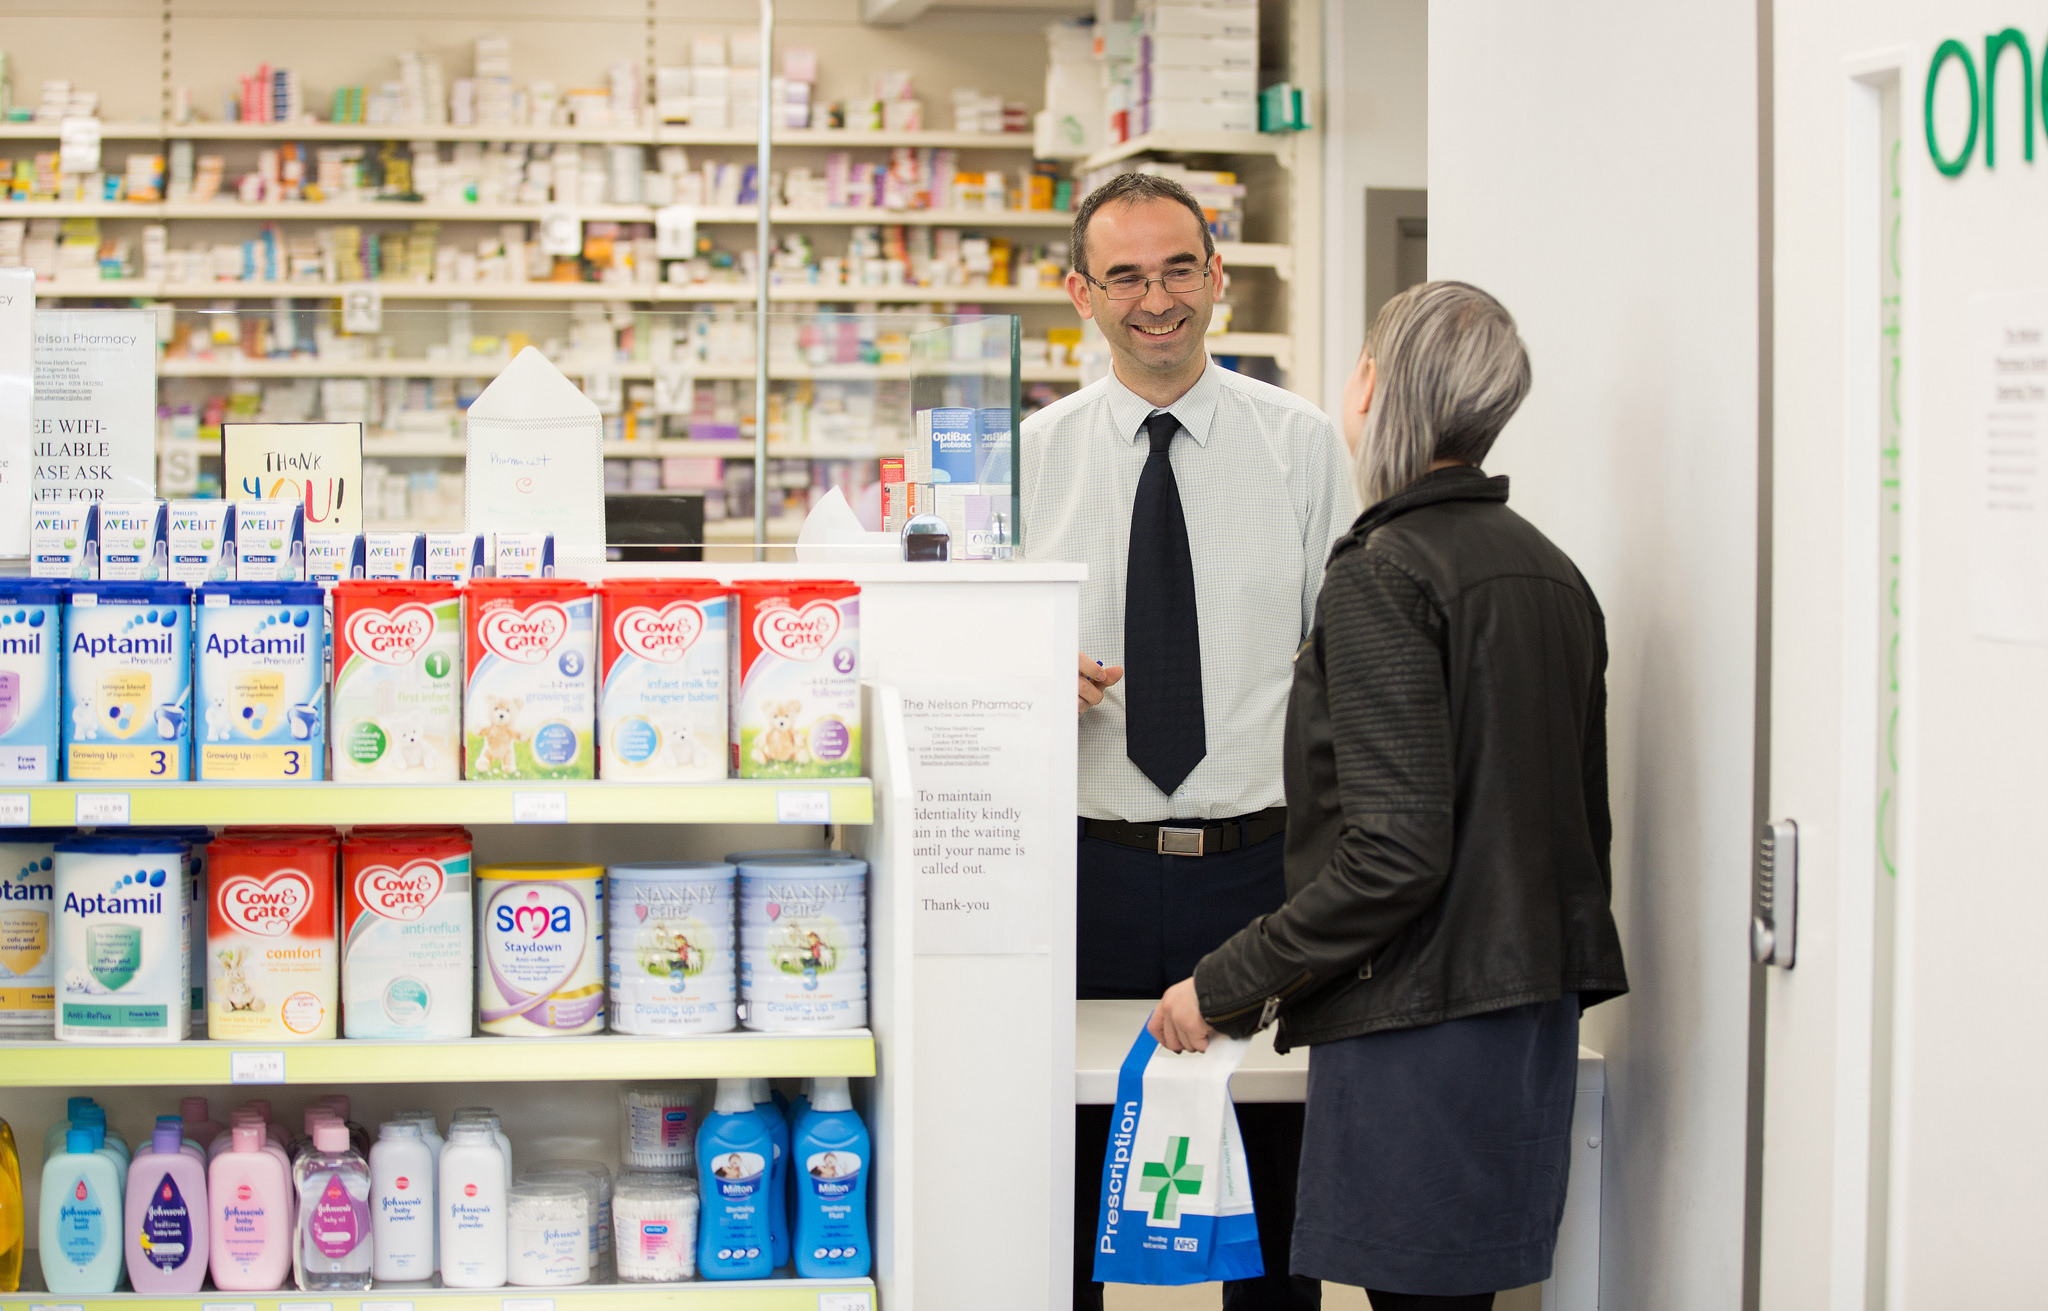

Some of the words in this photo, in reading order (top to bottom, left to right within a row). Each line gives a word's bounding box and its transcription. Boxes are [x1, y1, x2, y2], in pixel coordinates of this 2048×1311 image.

[1925, 28, 2048, 177] on
[73, 333, 137, 346] Pharmacy
[59, 419, 107, 434] WIFI-
[932, 431, 972, 442] OptiBac
[34, 442, 110, 457] ILABLE
[940, 441, 972, 449] probiotics
[75, 465, 114, 480] ASK
[34, 488, 62, 501] FF
[69, 488, 104, 501] FOR
[35, 519, 79, 530] AVENT
[104, 519, 149, 530] AVENT
[172, 519, 217, 530] AVENT
[241, 519, 285, 530] AVENT
[309, 547, 347, 557] AVENT
[370, 547, 407, 557] AVENT
[430, 547, 467, 557] AVENT
[500, 547, 537, 557] AVENT
[73, 632, 172, 658] Aptamil
[206, 632, 305, 658] Aptamil
[371, 636, 415, 652] Gate
[505, 635, 549, 651] Gate
[641, 634, 685, 651] Gate
[781, 632, 823, 649] Gate
[434, 654, 442, 676] 1
[565, 653, 579, 674] 3
[838, 649, 851, 671] 2
[647, 679, 680, 690] infant
[640, 692, 686, 705] hungrier
[903, 699, 924, 710] The
[928, 699, 968, 710] Nelson
[972, 699, 1034, 712] Pharmacy
[73, 752, 105, 761] Growing
[106, 752, 118, 761] Up
[150, 750, 167, 775] 3
[206, 752, 238, 761] Growing
[239, 752, 252, 761] Up
[284, 750, 300, 775] 3
[917, 790, 934, 802] To
[937, 790, 992, 802] maintain
[981, 808, 1022, 822] kindly
[935, 826, 947, 838] in
[951, 826, 970, 838] the
[974, 826, 1021, 840] waiting
[912, 844, 942, 857] until
[945, 846, 975, 859] your
[977, 847, 1012, 857] name
[1014, 845, 1026, 857] is
[921, 862, 959, 874] called
[962, 864, 986, 874] out.
[0, 880, 53, 901] tam
[634, 883, 718, 906] NANNY
[766, 882, 849, 905] NANNY
[63, 891, 162, 918] Aptamil
[380, 891, 425, 908] Gate
[921, 898, 991, 913] Thank-you
[243, 905, 290, 922] Gate
[401, 921, 461, 935] anti-reflux
[266, 945, 322, 959] comfort
[504, 941, 562, 954] Staydown
[669, 969, 686, 993] 3
[802, 967, 819, 991] 3
[634, 1002, 679, 1016] Growing
[681, 1004, 696, 1016] up
[698, 1002, 718, 1013] milk
[766, 1000, 812, 1014] Growing
[814, 1003, 829, 1014] up
[831, 999, 851, 1010] milk
[1100, 1101, 1138, 1254] Prescription
[723, 1184, 753, 1194] Milton
[818, 1183, 849, 1194] Milton
[1175, 1238, 1197, 1251] NHS
